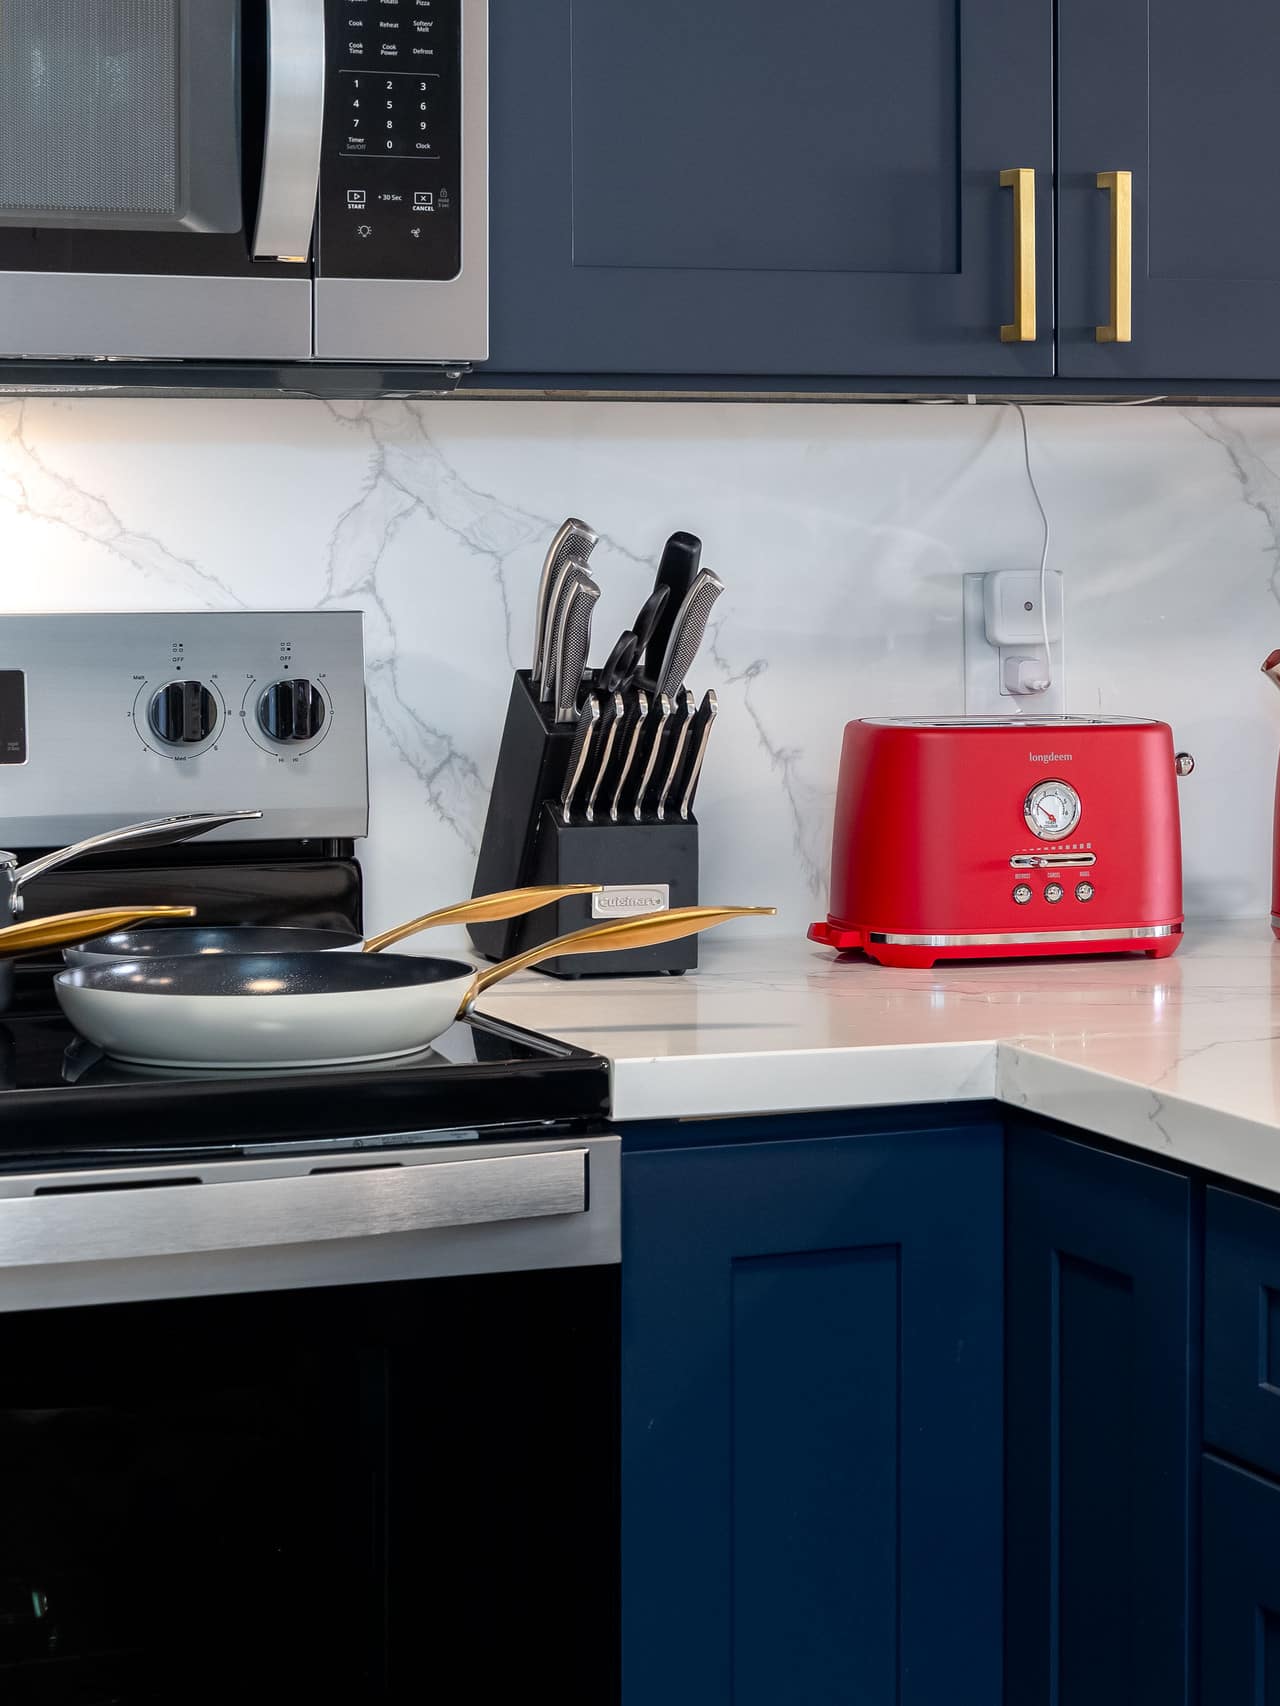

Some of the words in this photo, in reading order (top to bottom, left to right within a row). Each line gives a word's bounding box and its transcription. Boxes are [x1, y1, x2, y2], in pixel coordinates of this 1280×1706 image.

[353, 80, 359, 88] 1
[386, 81, 393, 90] 2
[420, 82, 427, 91] 3
[353, 99, 359, 108] 4
[386, 101, 393, 109] 5
[420, 102, 427, 111] 6
[353, 119, 360, 128] 7
[386, 120, 393, 129] 8
[420, 121, 427, 130] 9
[386, 140, 393, 149] 0
[1029, 751, 1073, 764] longdeem
